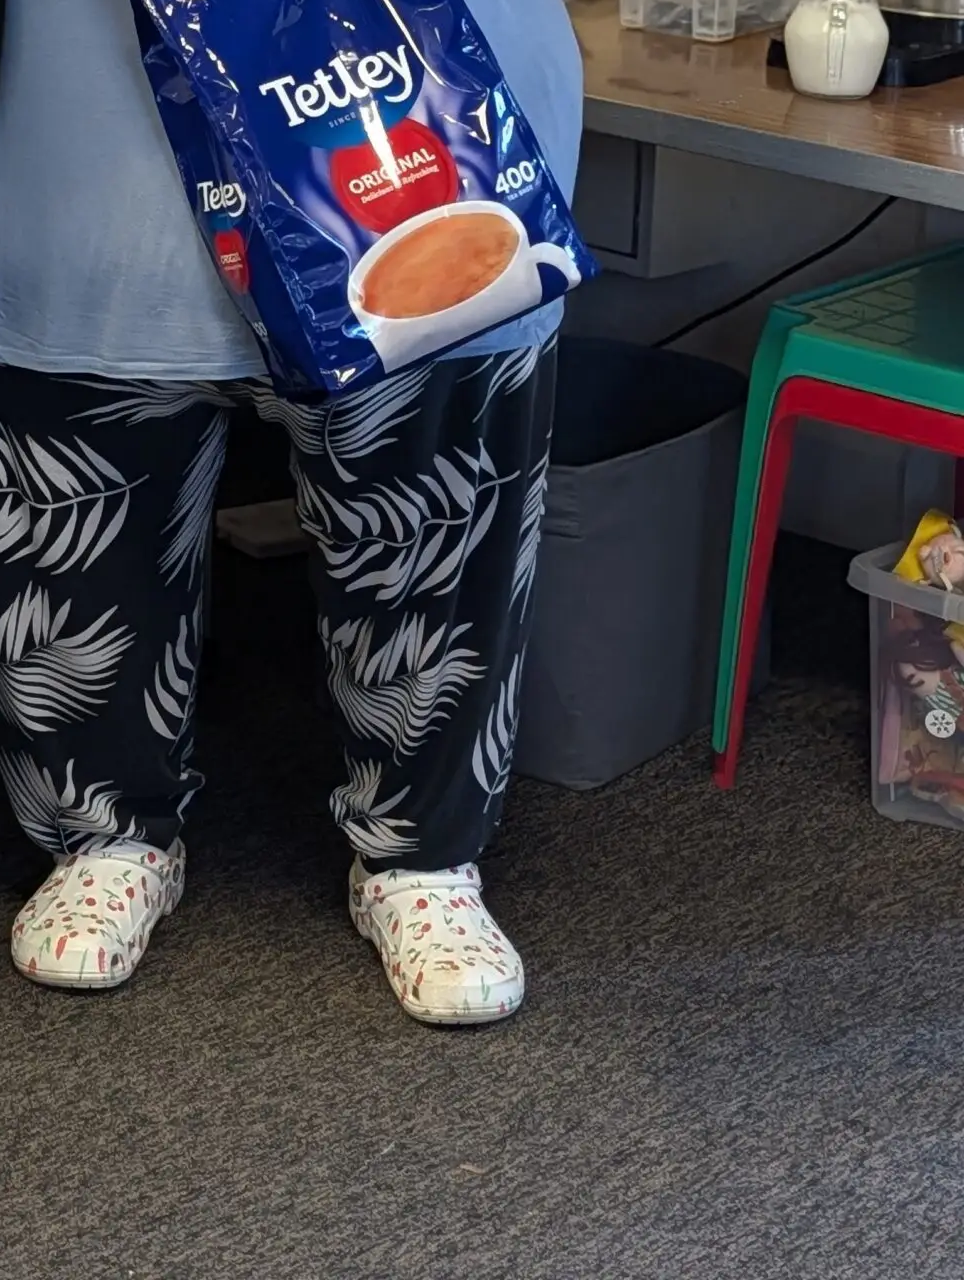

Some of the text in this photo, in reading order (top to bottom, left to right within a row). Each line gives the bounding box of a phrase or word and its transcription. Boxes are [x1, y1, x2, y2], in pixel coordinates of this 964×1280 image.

[258, 44, 413, 128] Tetley
[349, 148, 436, 194] ORIGNAL
[495, 160, 536, 194] 400
